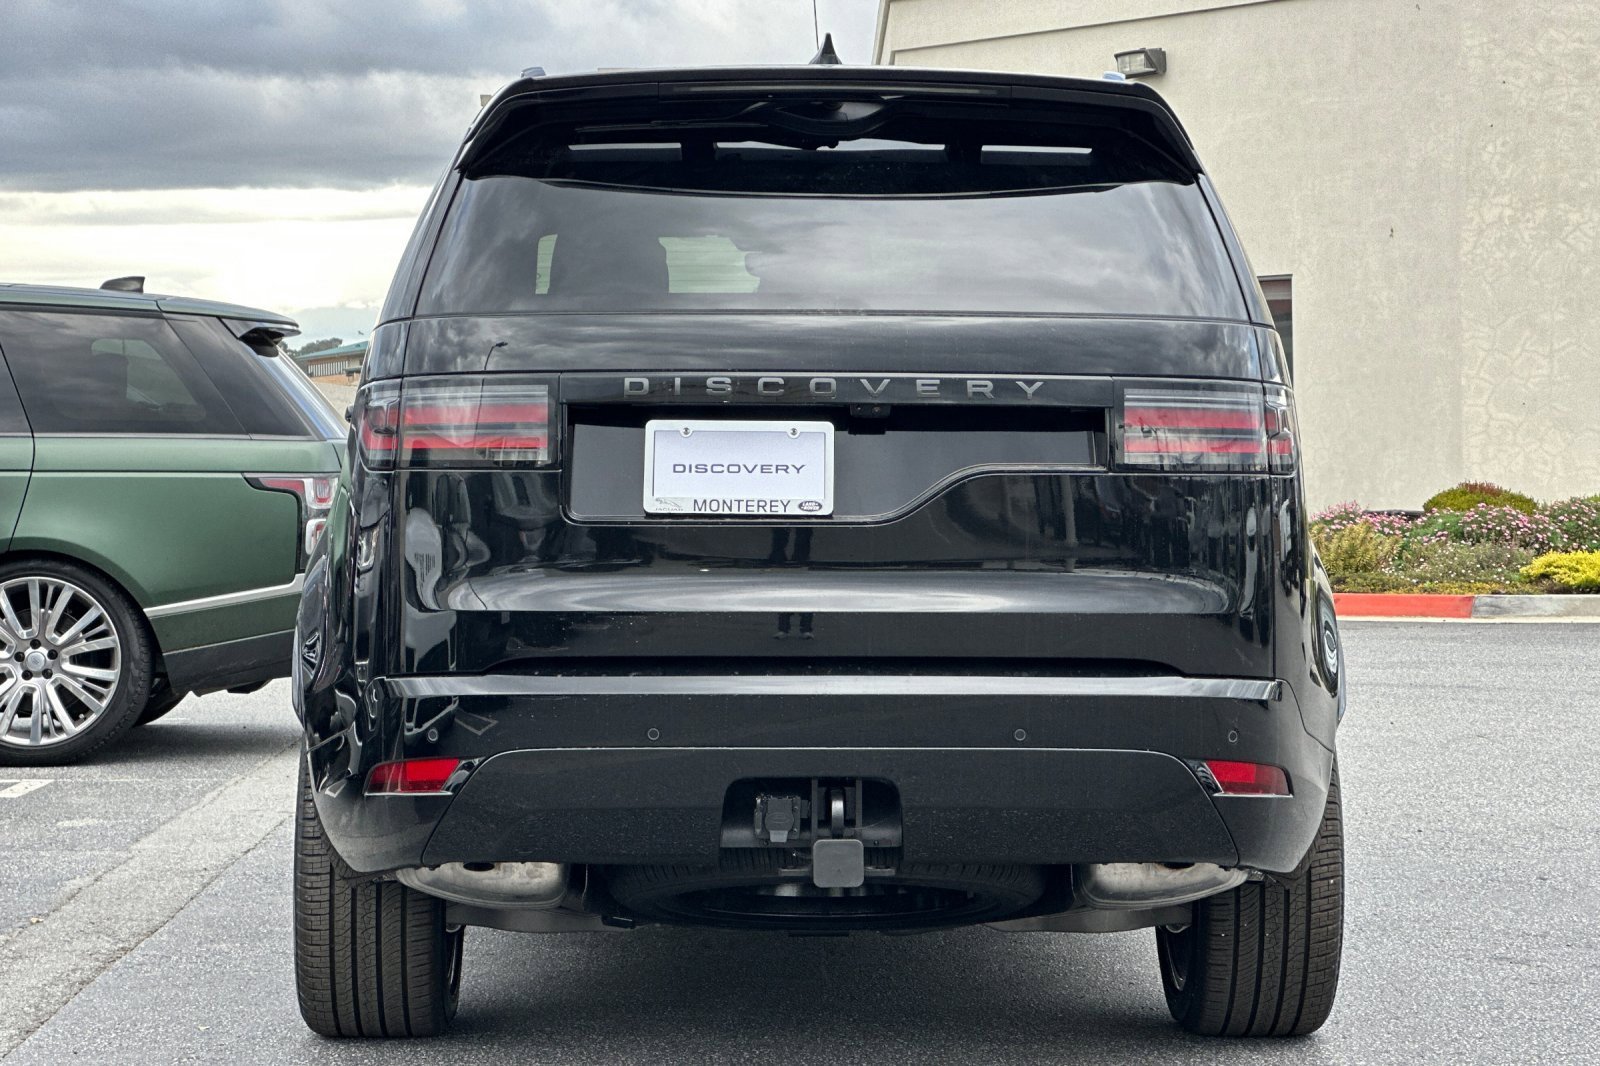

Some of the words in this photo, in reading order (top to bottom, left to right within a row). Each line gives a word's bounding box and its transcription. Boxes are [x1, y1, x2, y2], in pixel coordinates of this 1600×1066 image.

[623, 377, 1045, 400] DISCOVERY
[672, 463, 806, 474] DISCOVERY
[693, 499, 791, 513] MONTEREY
